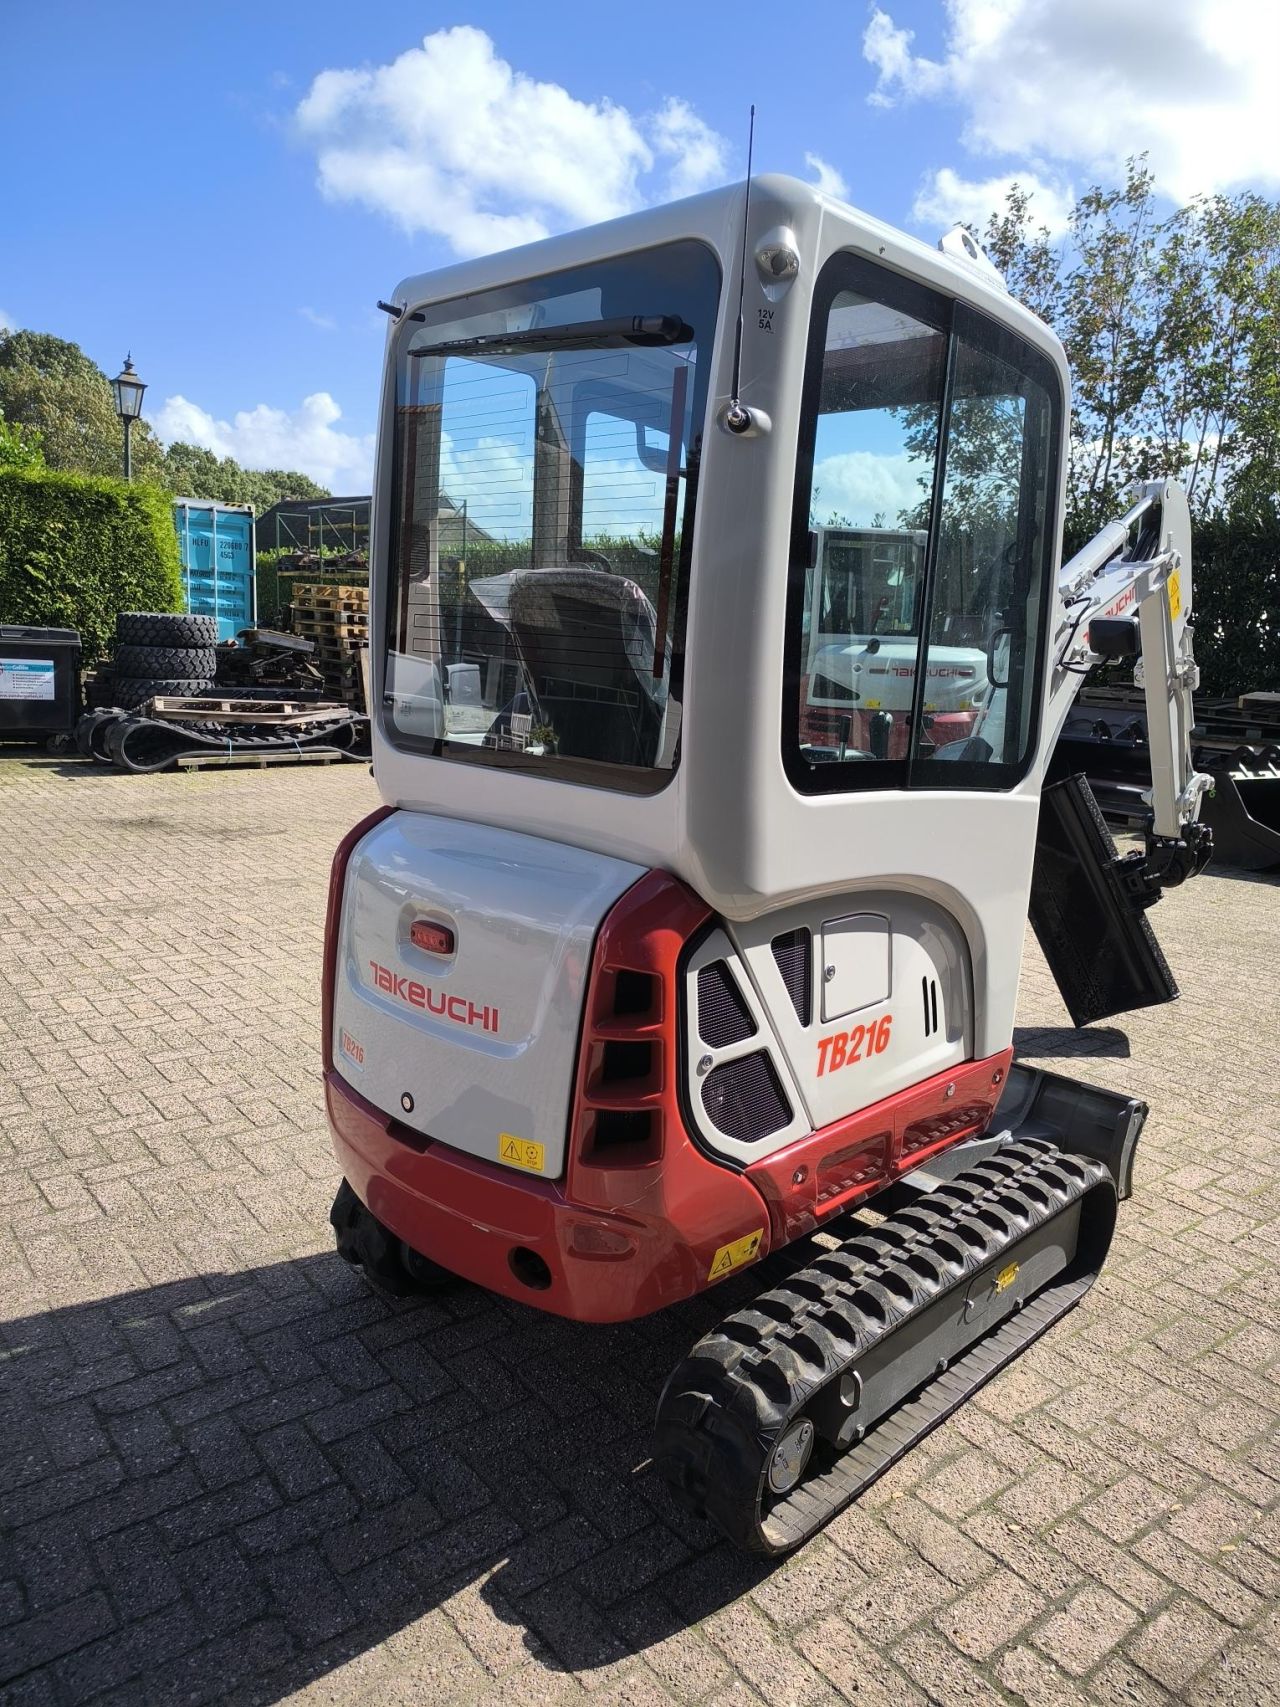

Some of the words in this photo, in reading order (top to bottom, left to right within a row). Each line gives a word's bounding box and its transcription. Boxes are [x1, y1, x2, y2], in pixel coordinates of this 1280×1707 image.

[758, 309, 774, 319] 12V
[758, 319, 771, 330] 5A
[343, 1032, 364, 1064] TB216
[816, 1014, 893, 1078] TB216
